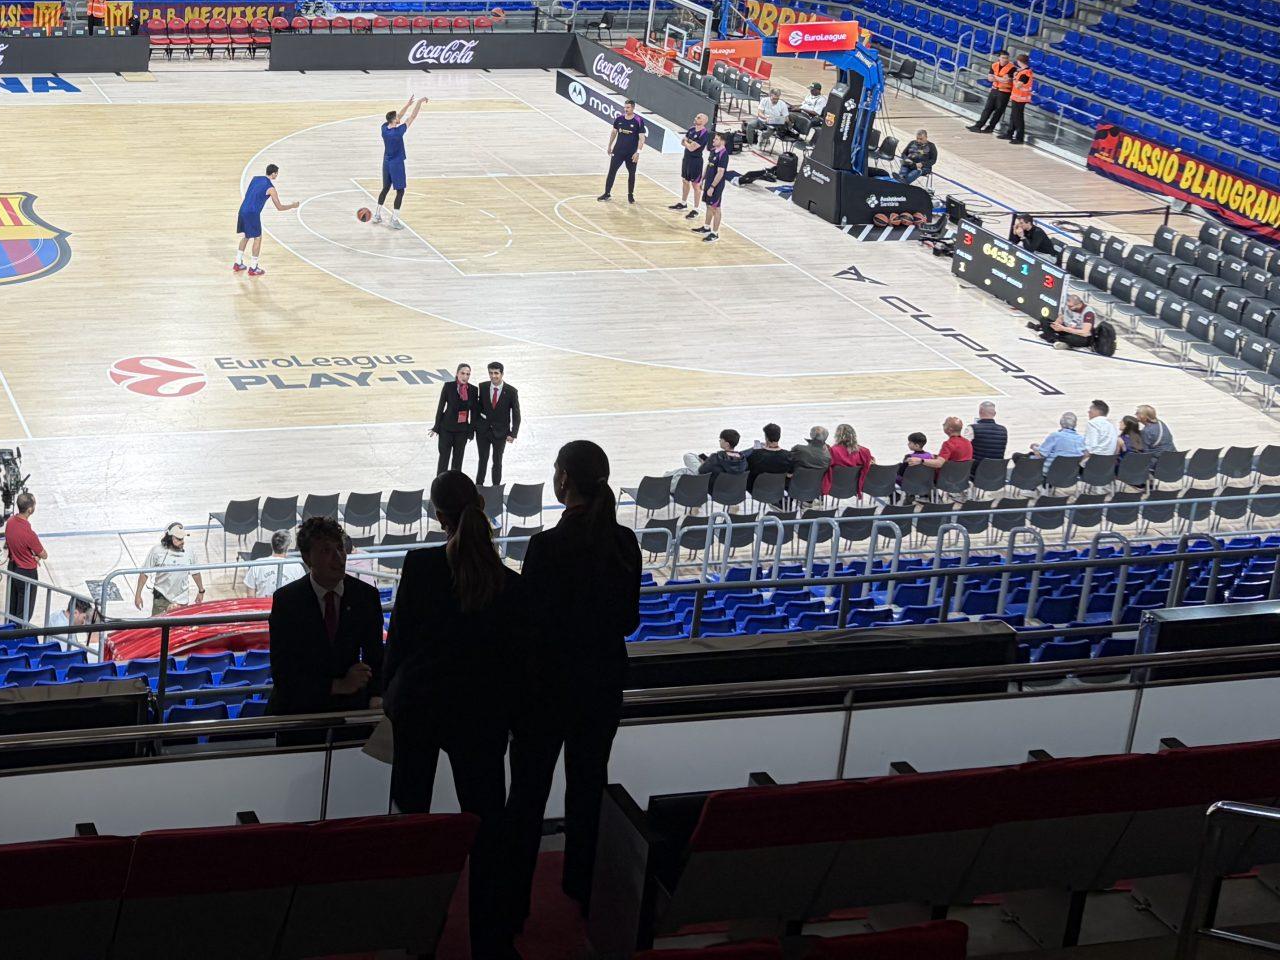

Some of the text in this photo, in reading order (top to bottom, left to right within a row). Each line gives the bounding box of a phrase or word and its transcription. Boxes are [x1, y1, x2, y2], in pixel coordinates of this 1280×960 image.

[804, 33, 847, 43] EuroLeague
[408, 39, 479, 64] Coca-Cola
[593, 53, 634, 90] Coca-Cola
[1118, 136, 1280, 228] PASSIÓ BLAUGRAN
[963, 233, 974, 245] 3
[879, 296, 1065, 396] CUPRA
[214, 352, 416, 370] EuroLeague
[227, 368, 456, 391] PLAY-IN
